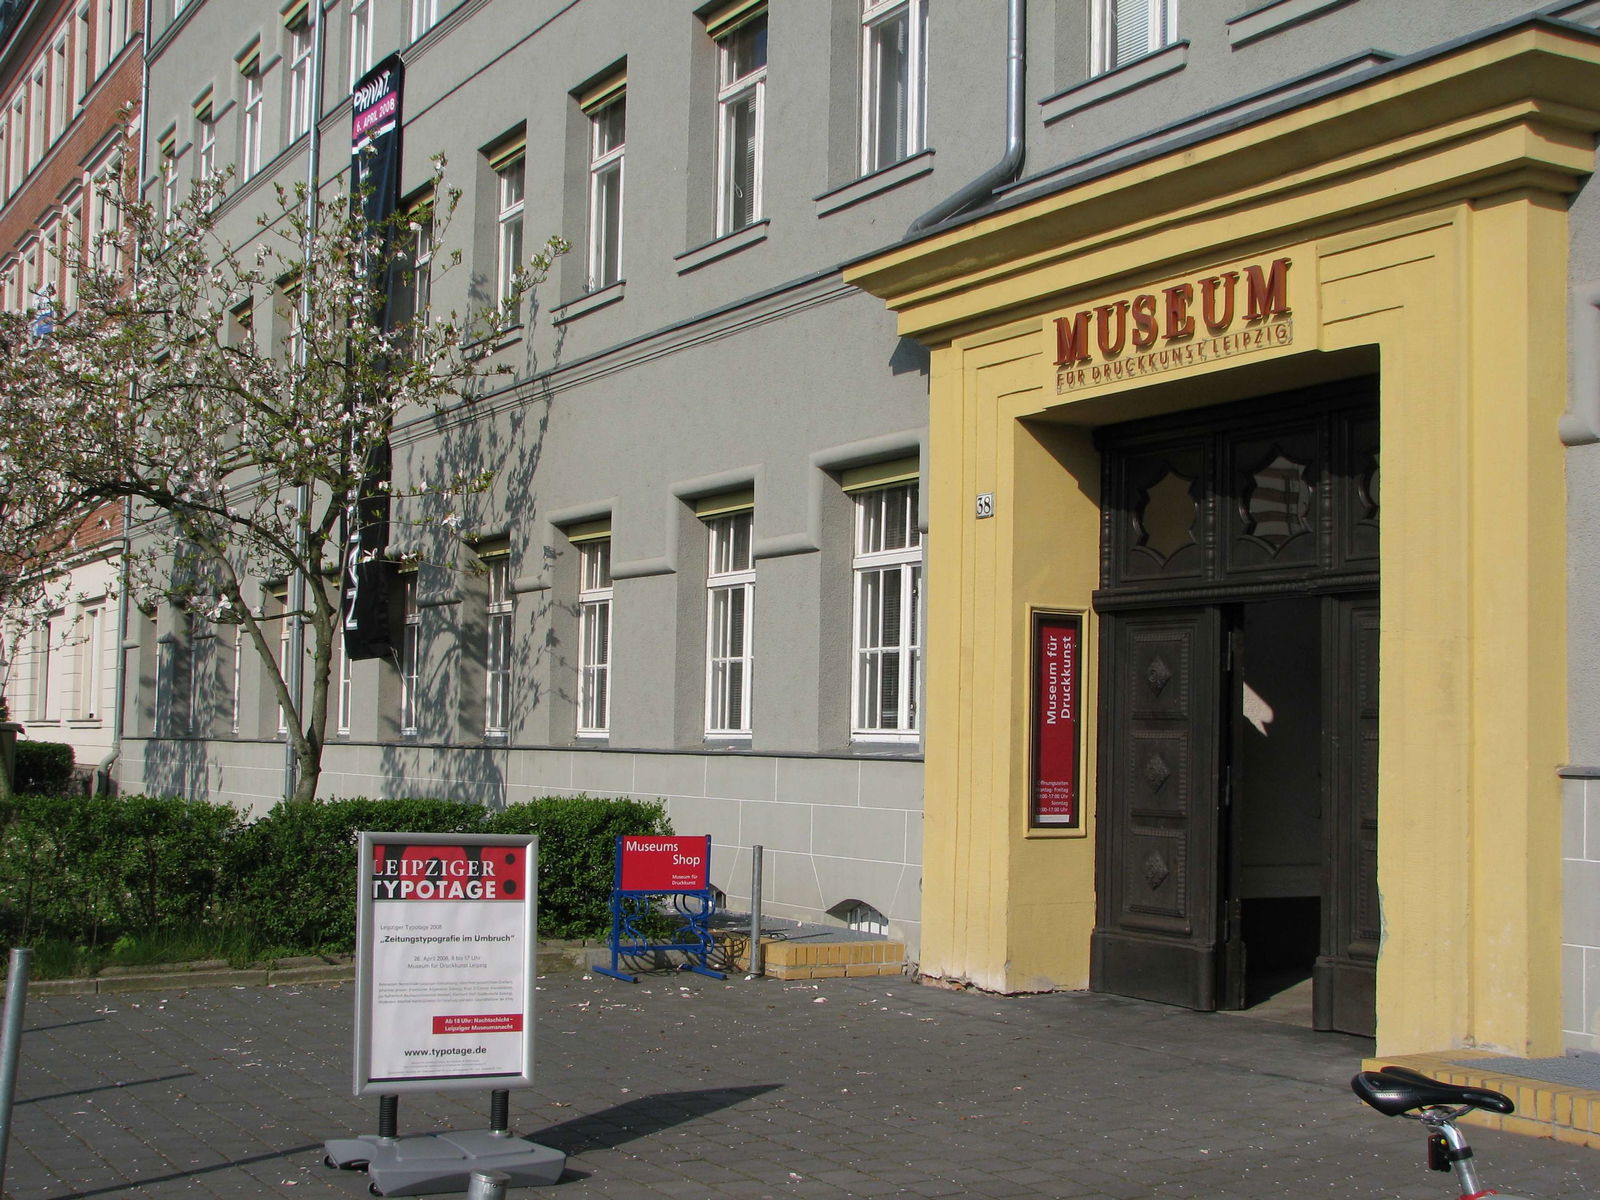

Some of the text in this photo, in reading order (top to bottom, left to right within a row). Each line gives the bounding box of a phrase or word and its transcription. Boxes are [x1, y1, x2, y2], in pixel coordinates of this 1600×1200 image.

[363, 110, 378, 128] APRIL
[379, 98, 395, 118] 2008
[1053, 257, 1292, 366] MUSEUM
[1092, 342, 1204, 380] DRUCKKUNST
[1212, 323, 1287, 354] LEIPZIG
[976, 496, 991, 515] 38
[1046, 635, 1058, 725] Museum für
[1060, 636, 1072, 719] Druckkunst
[626, 840, 679, 852] Museums
[373, 859, 496, 877] LEIPZIGER
[672, 854, 701, 867] Shop
[373, 879, 496, 899] TYPOTAGE
[404, 1046, 487, 1058] www.typotage.de
